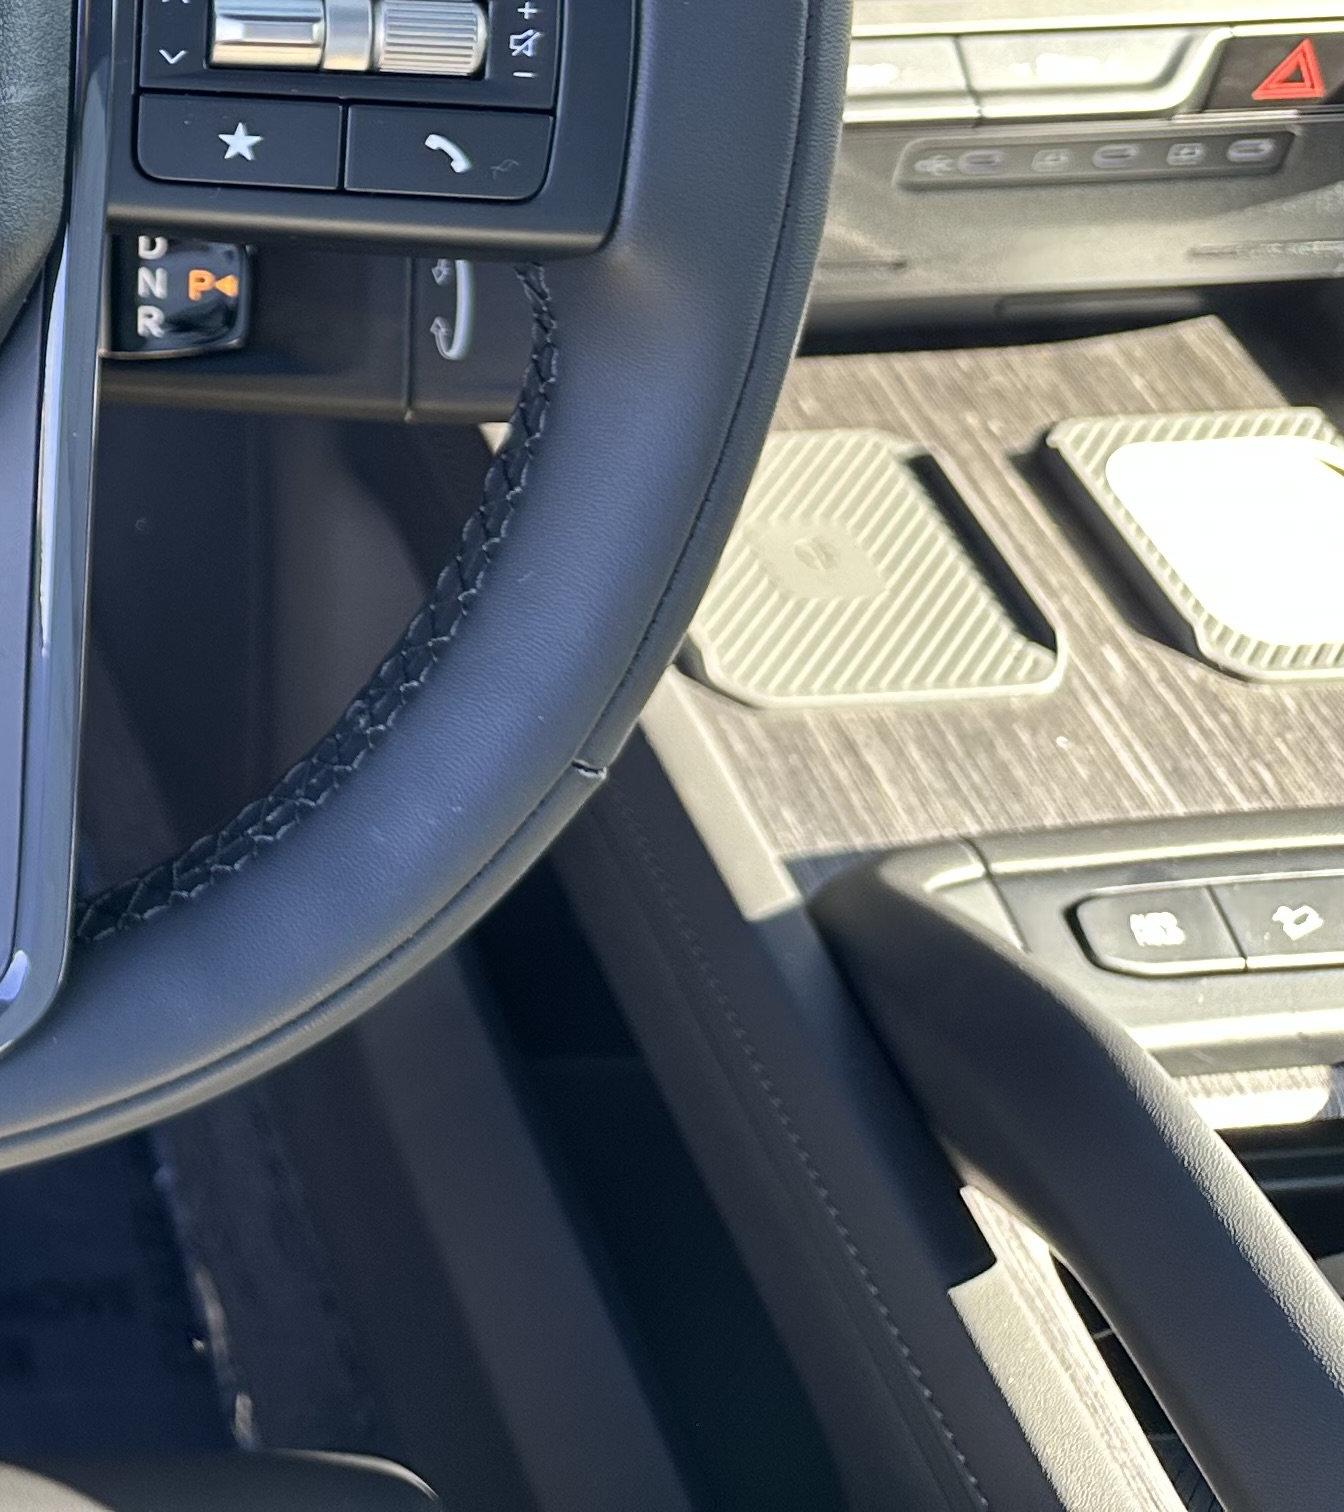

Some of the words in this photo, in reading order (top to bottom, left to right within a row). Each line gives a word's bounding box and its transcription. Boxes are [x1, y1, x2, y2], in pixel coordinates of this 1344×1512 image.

[138, 235, 169, 261] D
[137, 266, 169, 300] N
[187, 269, 217, 302] P
[137, 304, 166, 339] R
